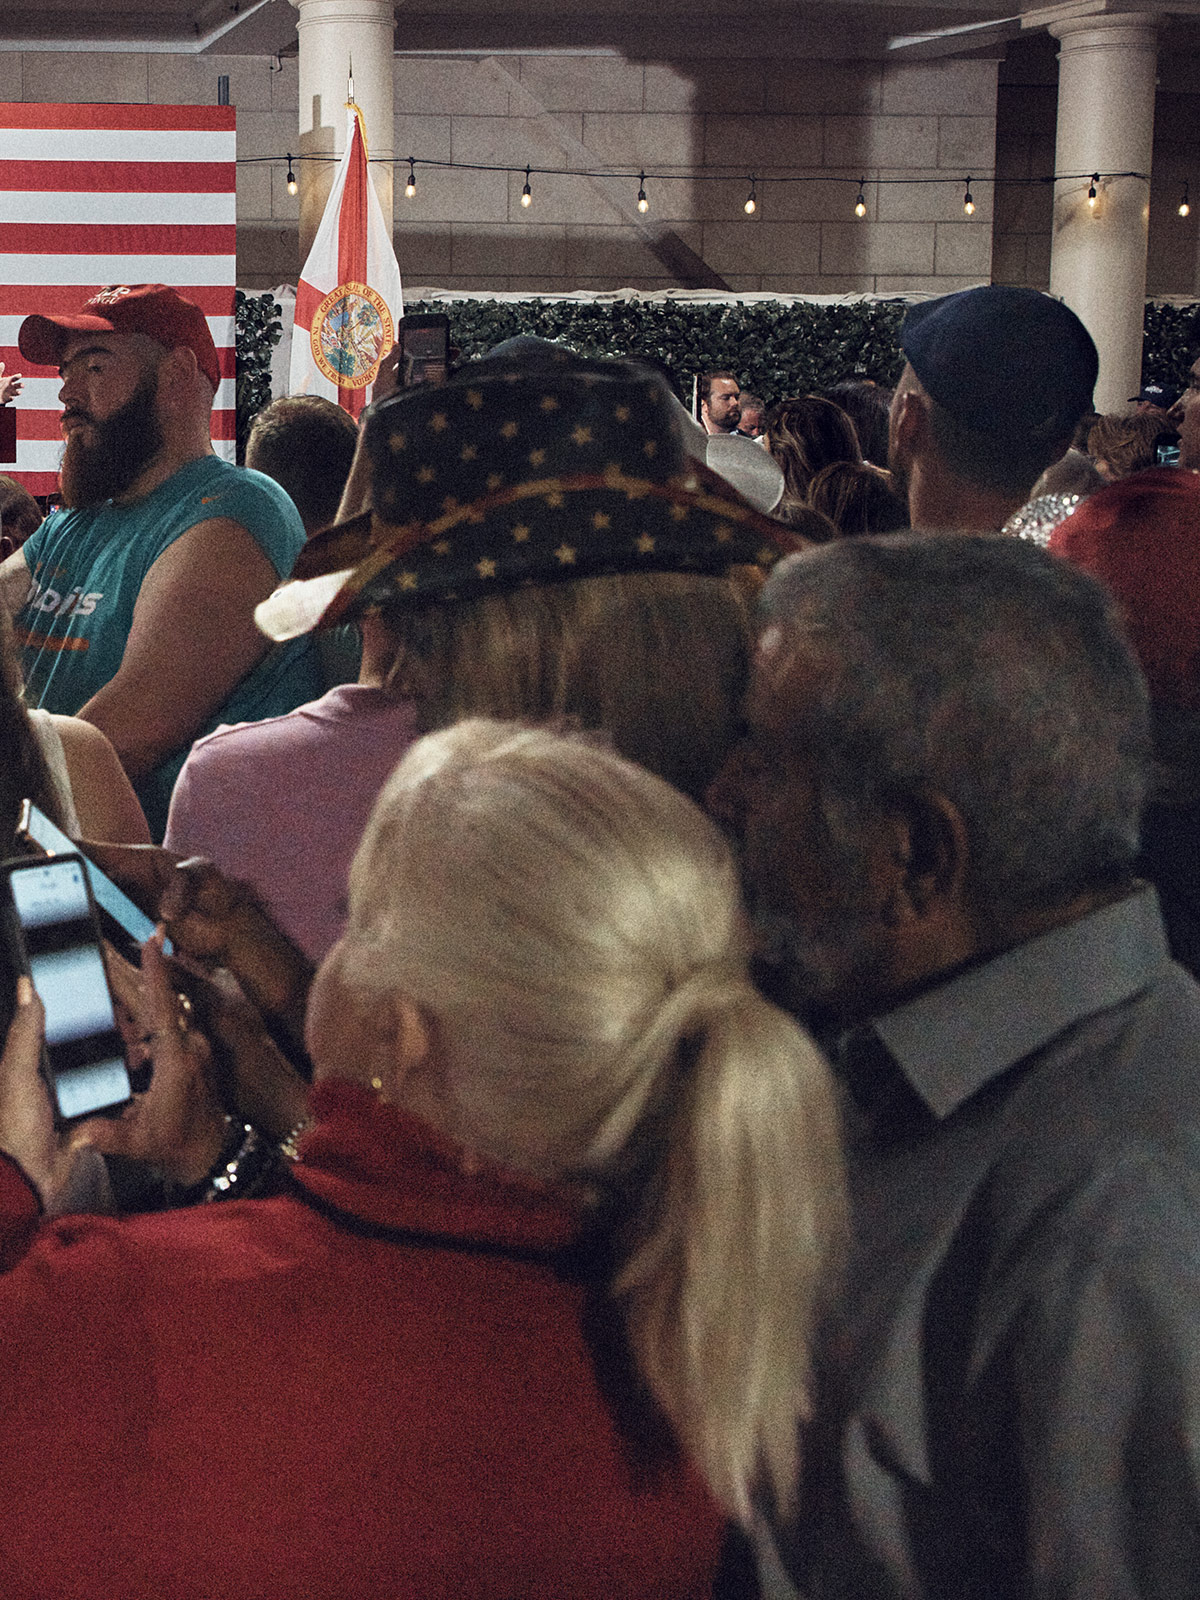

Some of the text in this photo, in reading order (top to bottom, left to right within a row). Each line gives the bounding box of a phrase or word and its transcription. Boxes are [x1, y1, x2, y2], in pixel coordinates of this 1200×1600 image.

[320, 288, 344, 313] GREAT
[362, 288, 374, 299] OF
[373, 296, 386, 315] THE
[384, 317, 392, 345] STATE
[312, 326, 319, 336] IN
[312, 338, 320, 356] GOD
[318, 358, 328, 370] WE
